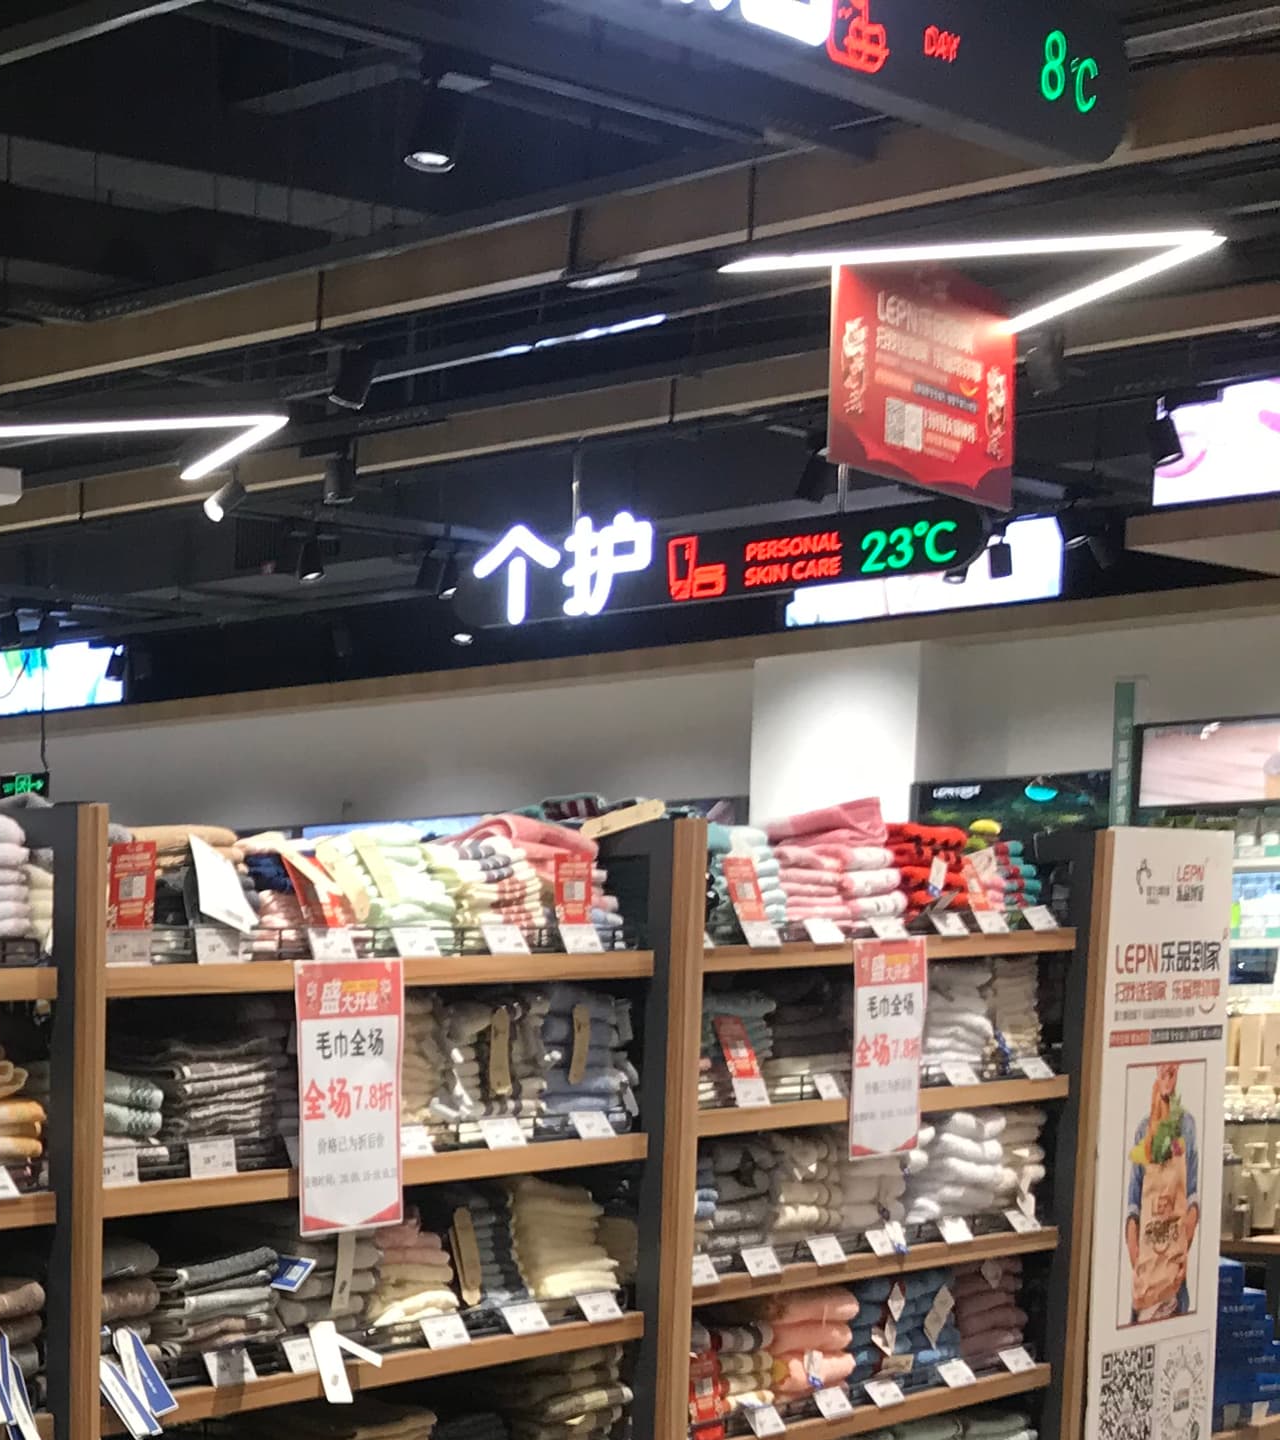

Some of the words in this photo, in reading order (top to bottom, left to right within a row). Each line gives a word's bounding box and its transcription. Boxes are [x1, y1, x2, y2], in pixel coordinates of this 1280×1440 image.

[745, 531, 842, 562] PERSONAL
[473, 511, 654, 625] 个护
[745, 561, 789, 587] SKIN
[790, 556, 842, 580] CARE
[1176, 864, 1204, 883] LEPN
[1115, 944, 1158, 974] LEPN
[867, 991, 914, 1020] 毛巾全场
[316, 1028, 384, 1060] 毛巾全场
[304, 1078, 393, 1121] 全场7.8折
